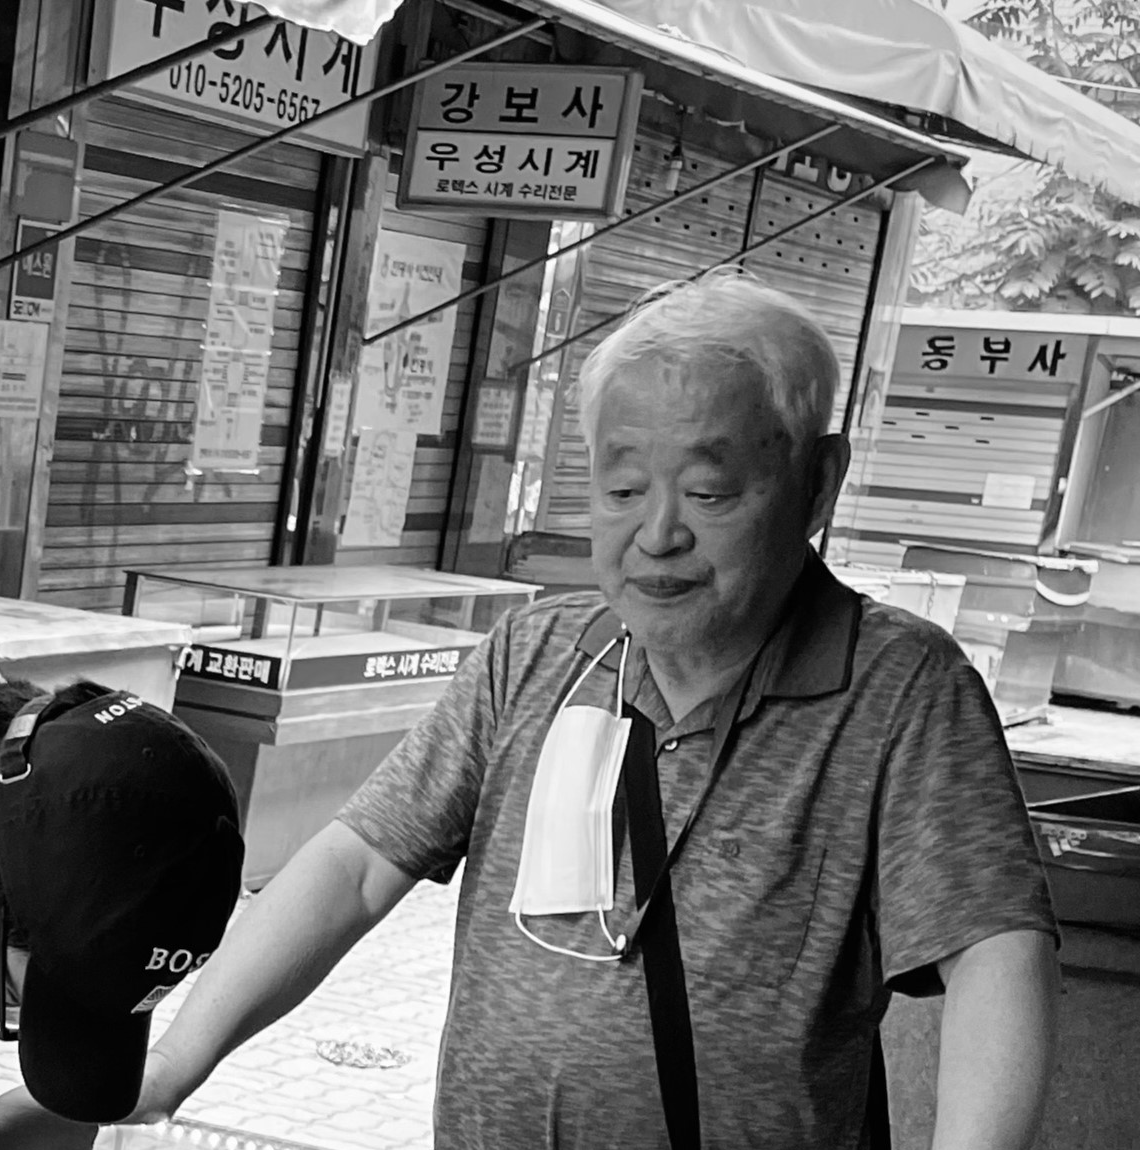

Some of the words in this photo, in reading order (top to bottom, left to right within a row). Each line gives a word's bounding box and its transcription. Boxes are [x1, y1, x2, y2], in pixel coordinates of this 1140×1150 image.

[169, 61, 321, 122] 010-5205-6567
[440, 82, 604, 128] 강보사
[425, 142, 600, 179] 우성시계
[436, 179, 479, 195] 로렉스
[483, 182, 514, 198] 시계
[518, 182, 578, 201] 수리전문
[921, 335, 1067, 377] 동부사
[205, 651, 271, 685] 교환판매
[397, 652, 420, 676] 시계
